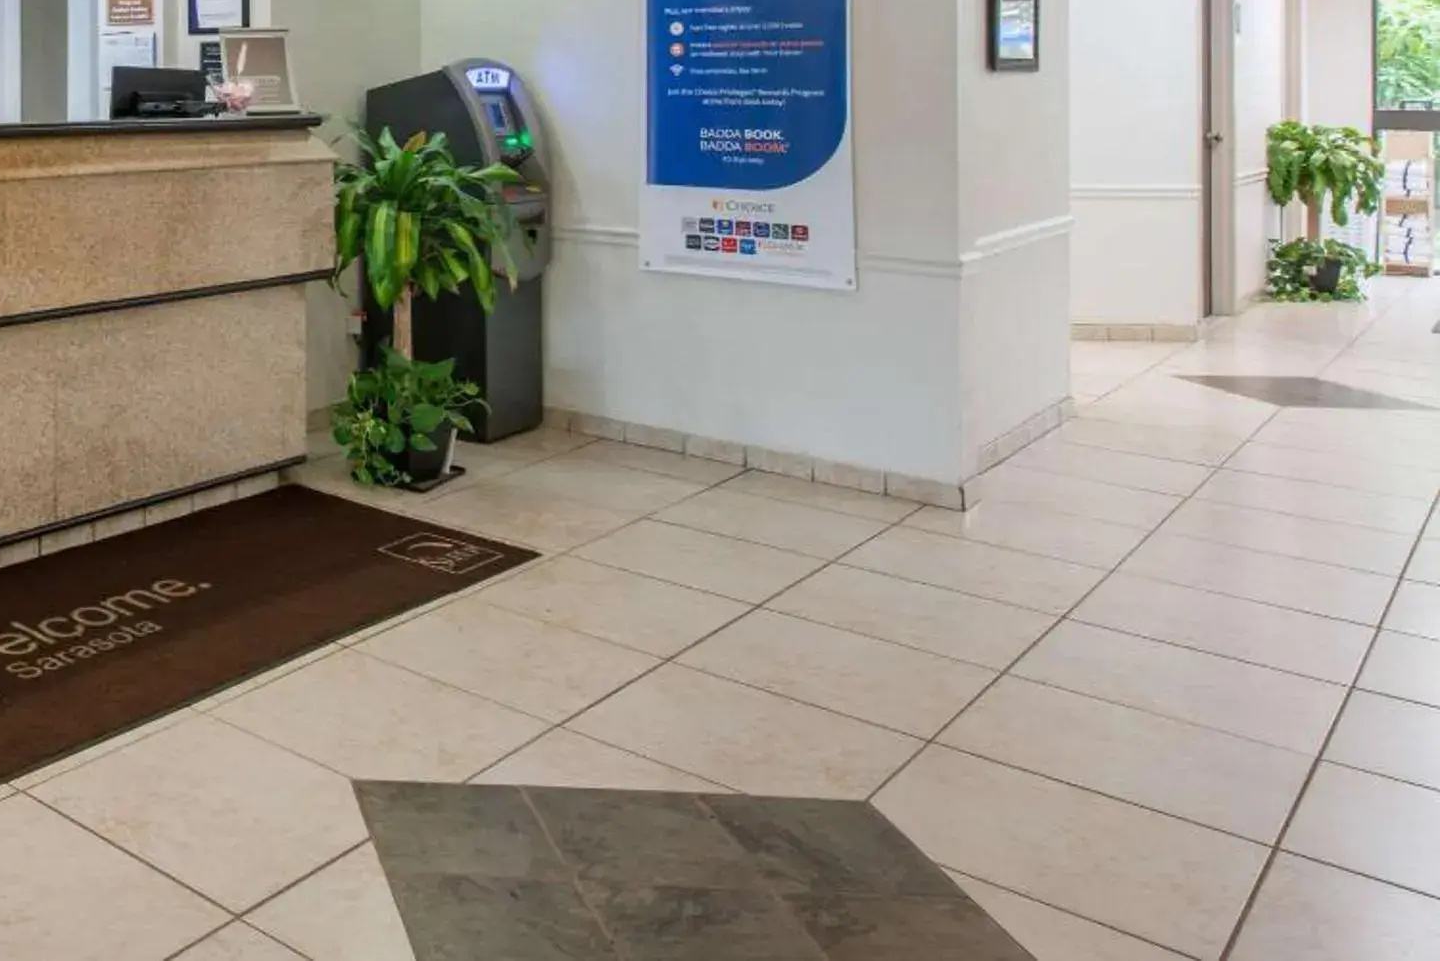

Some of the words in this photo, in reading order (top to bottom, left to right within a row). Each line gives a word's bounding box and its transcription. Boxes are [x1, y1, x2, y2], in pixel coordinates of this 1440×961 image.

[476, 71, 500, 84] ATM
[700, 127, 741, 139] BADDA
[744, 128, 785, 141] BOOK.
[700, 140, 742, 152] BADDA
[5, 620, 164, 680] Sarasota
